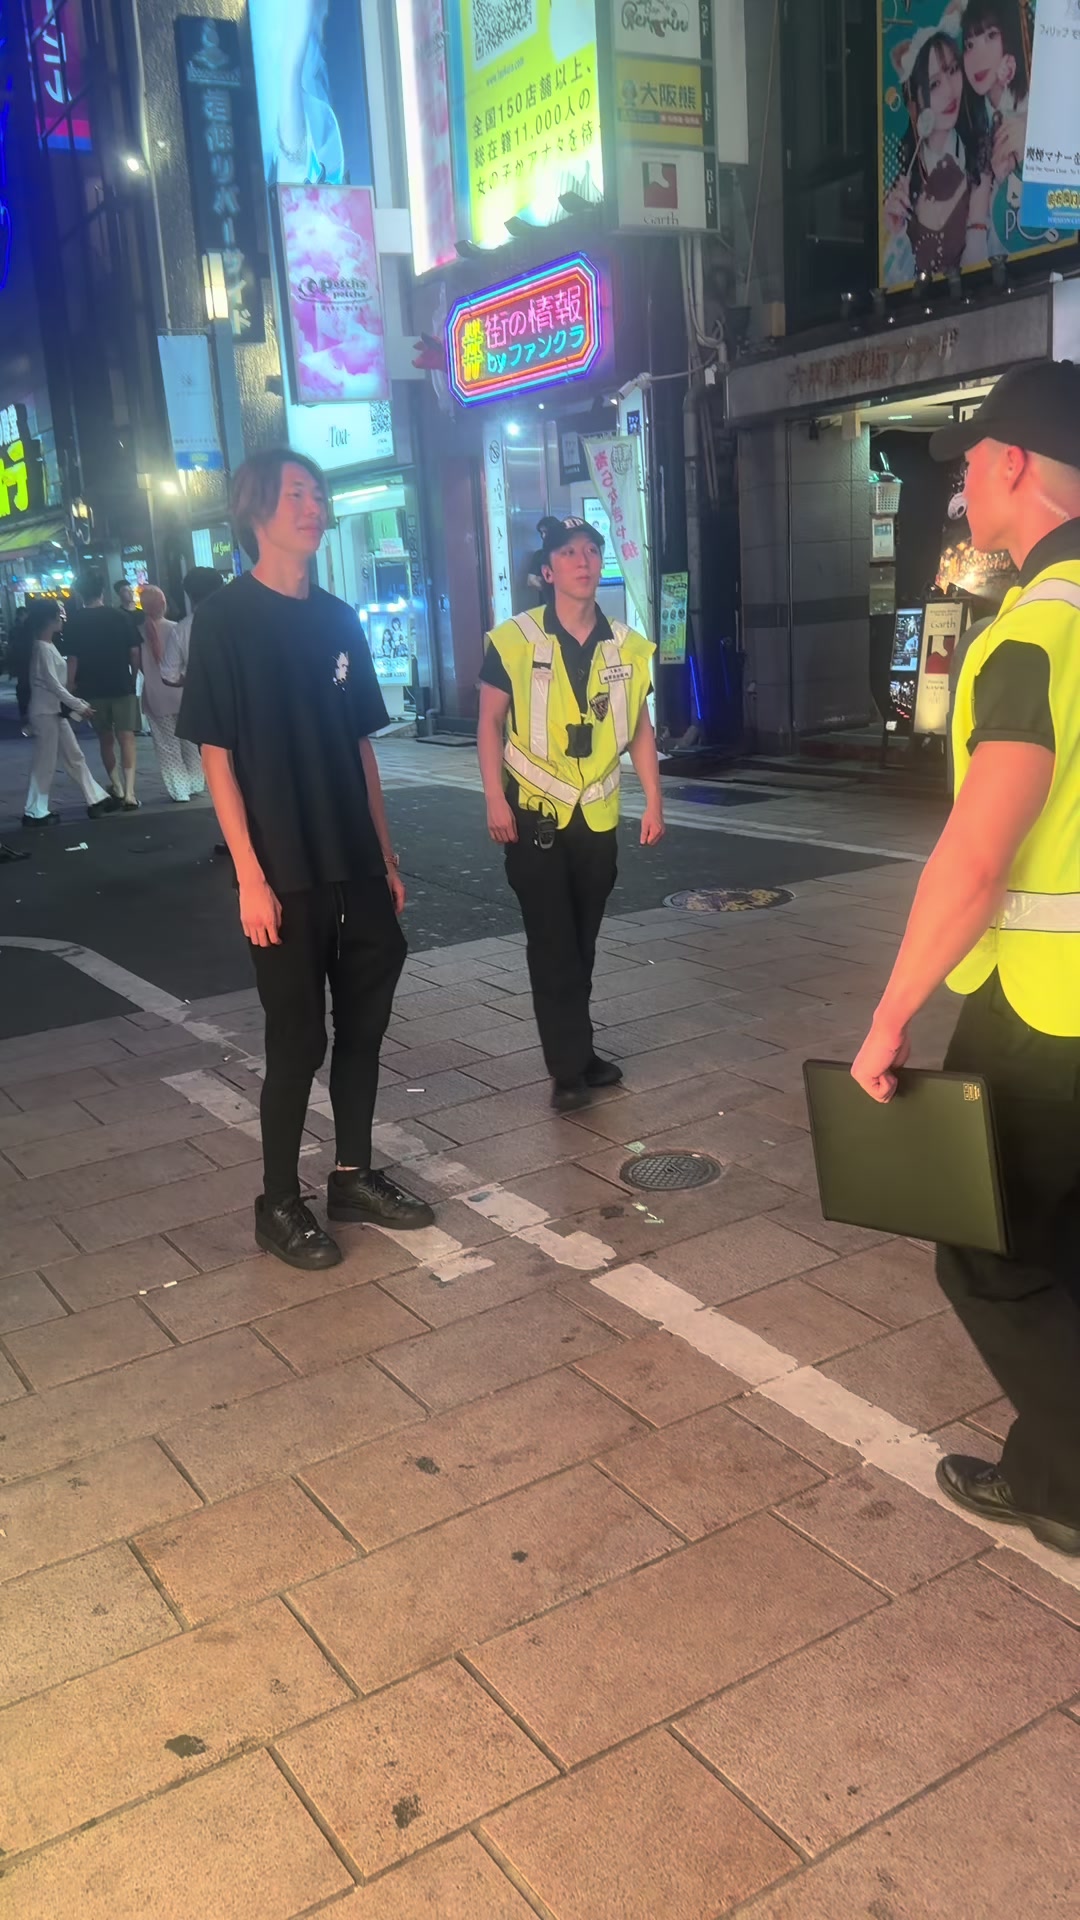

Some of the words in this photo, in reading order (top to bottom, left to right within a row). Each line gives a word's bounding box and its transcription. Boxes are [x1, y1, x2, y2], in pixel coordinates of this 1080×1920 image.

[640, 81, 696, 110] 大阪熊
[484, 284, 584, 349] 街の情報
[487, 352, 507, 374] by
[508, 324, 585, 367] ファンクラ
